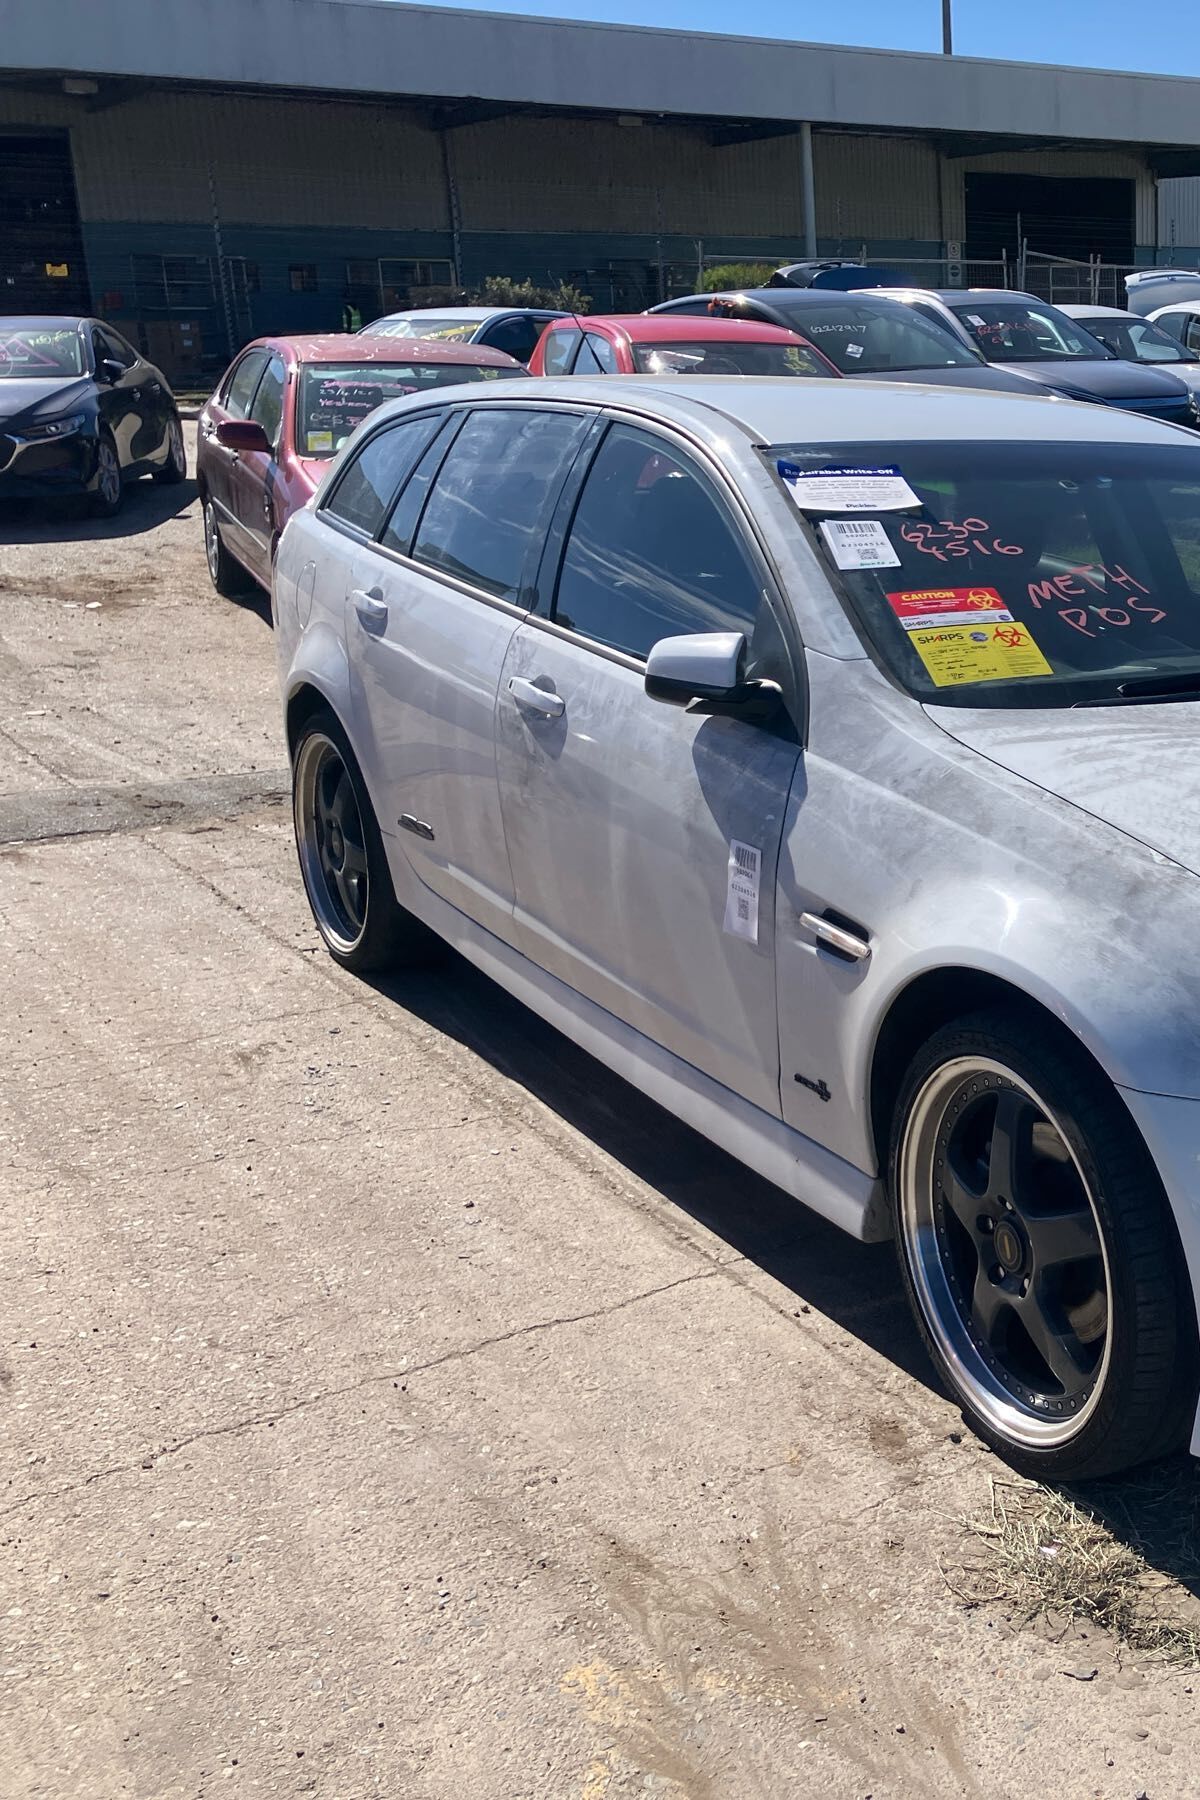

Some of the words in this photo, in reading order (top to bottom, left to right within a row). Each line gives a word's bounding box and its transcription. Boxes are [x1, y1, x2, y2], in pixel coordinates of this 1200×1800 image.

[784, 467, 841, 477] Repairable
[901, 517, 989, 542] 6230
[917, 539, 1024, 562] 4516
[1027, 563, 1151, 609] METH
[901, 591, 956, 601] CAUTION
[917, 632, 965, 644] SHARPS
